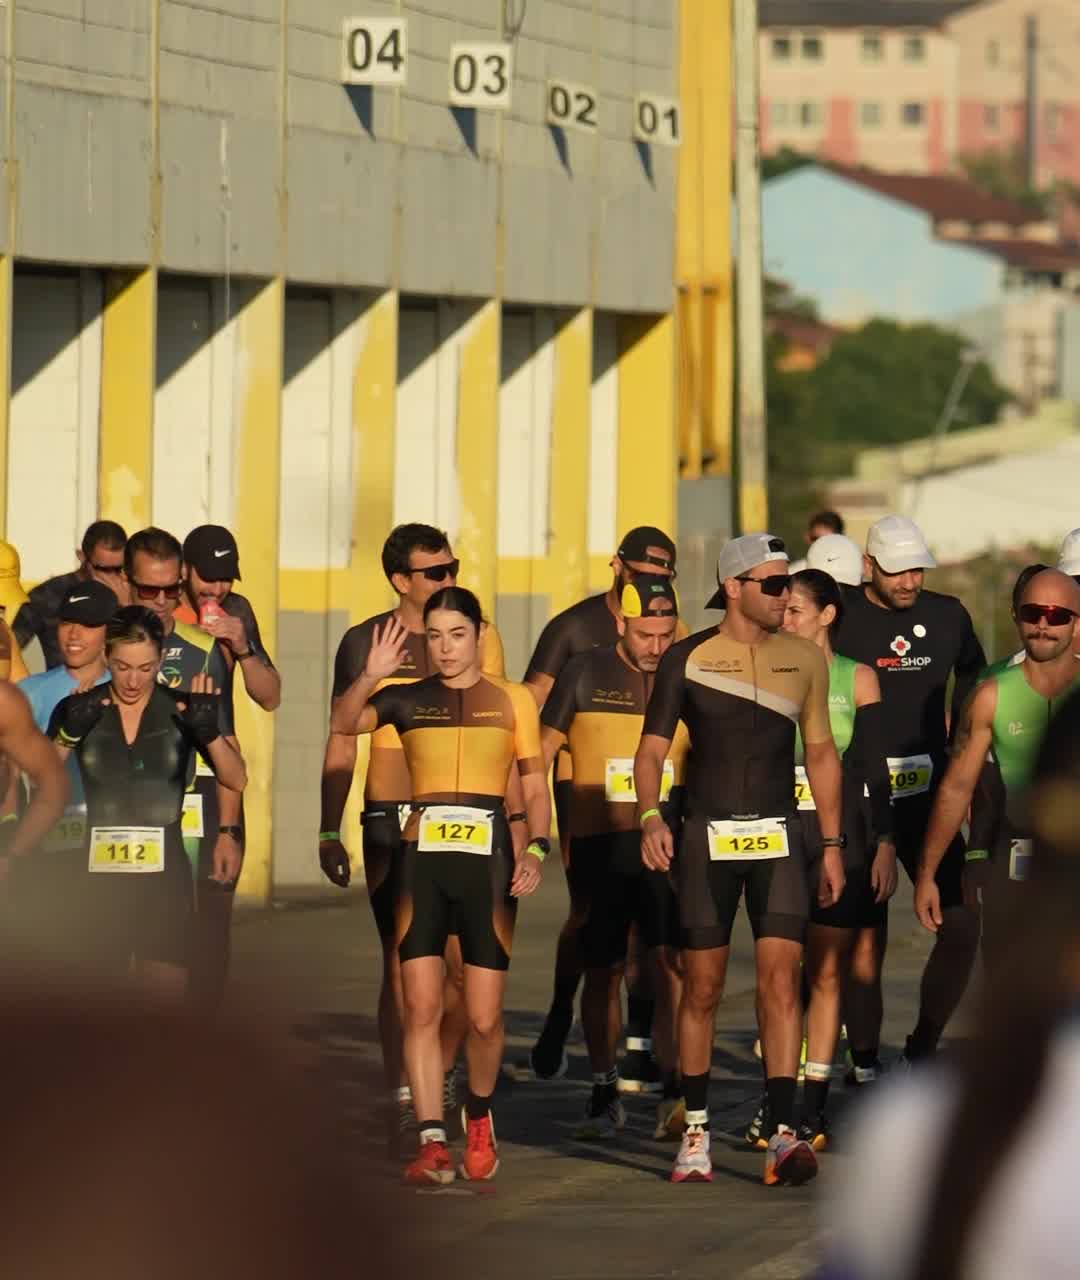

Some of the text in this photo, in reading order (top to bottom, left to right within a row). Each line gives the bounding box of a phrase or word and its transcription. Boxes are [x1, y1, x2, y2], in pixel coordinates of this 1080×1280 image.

[349, 27, 405, 72] 04
[453, 53, 507, 96] 03
[549, 86, 598, 127] 02
[638, 100, 679, 140] 01
[437, 823, 476, 840] 127
[729, 836, 769, 852] 125
[107, 843, 146, 861] 112
